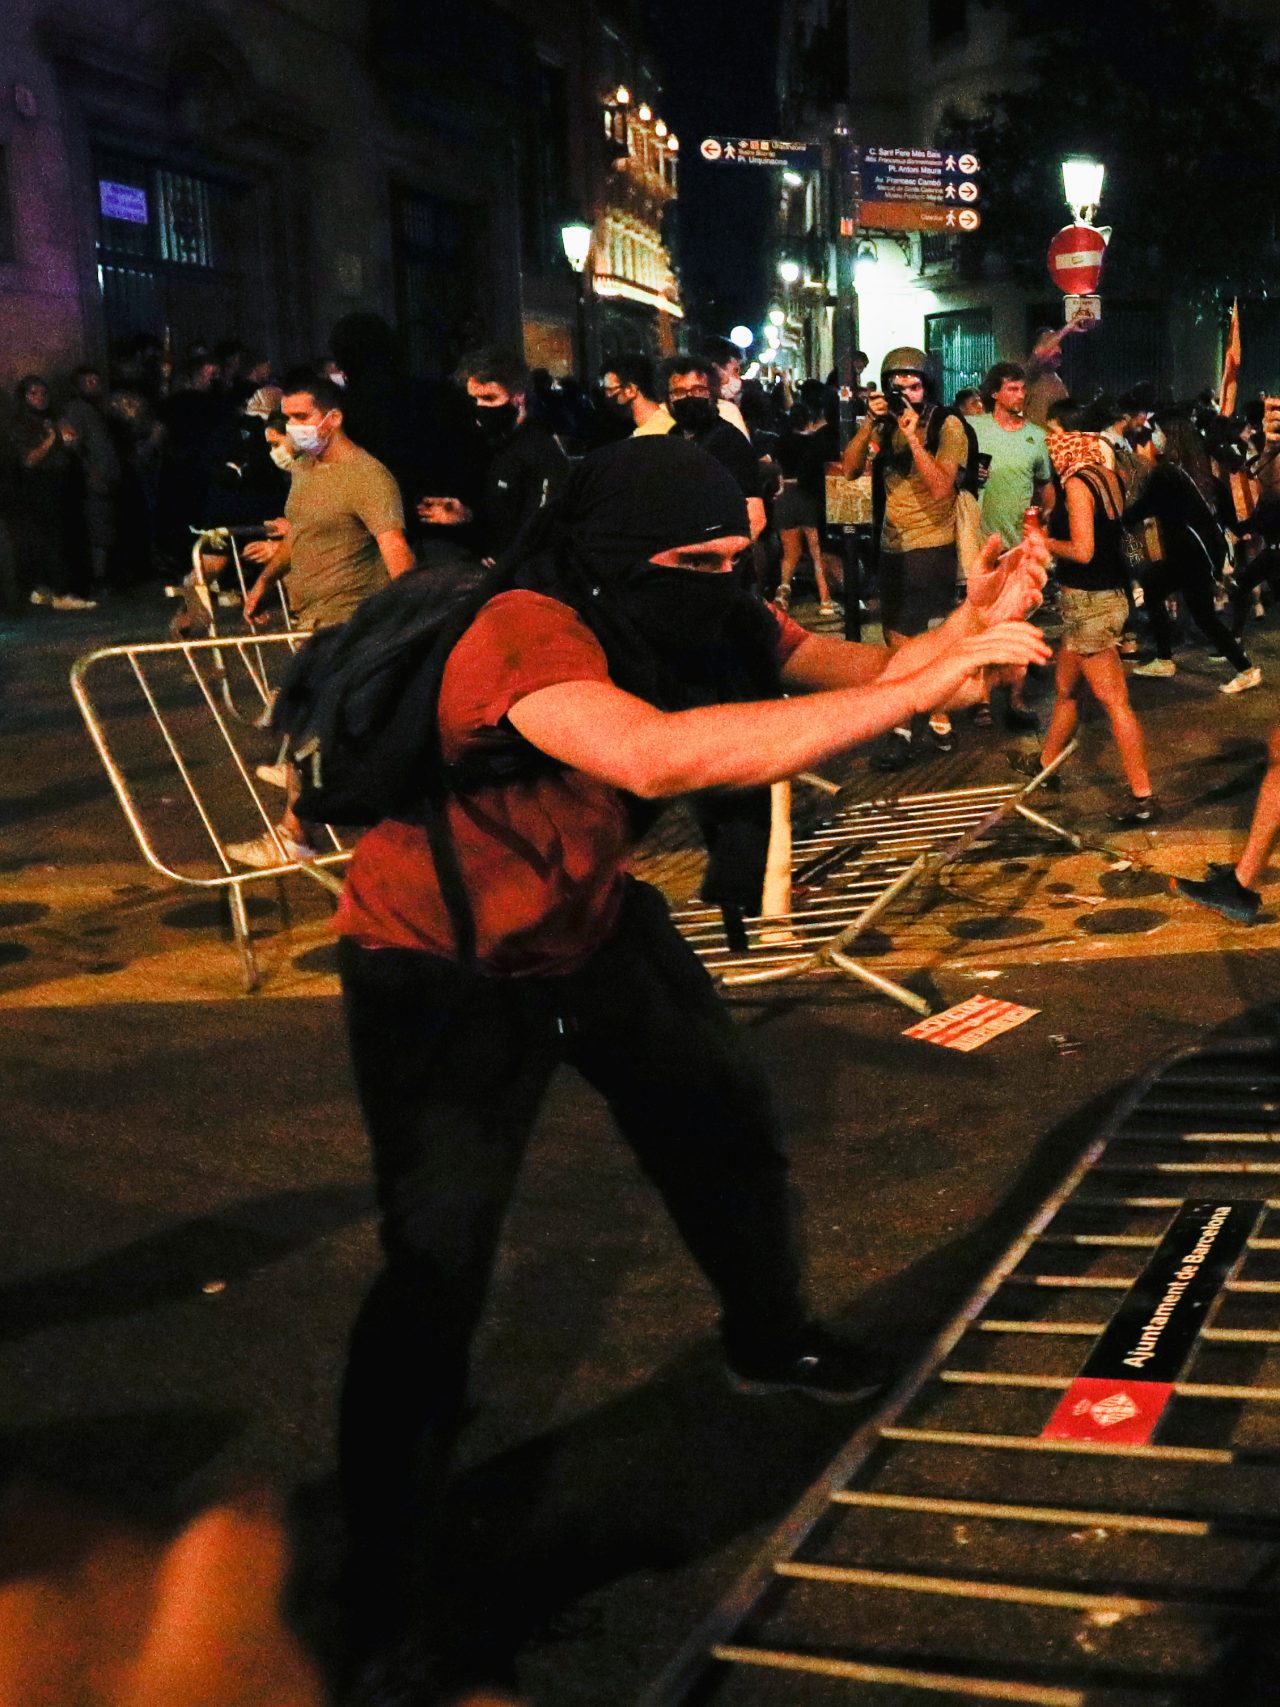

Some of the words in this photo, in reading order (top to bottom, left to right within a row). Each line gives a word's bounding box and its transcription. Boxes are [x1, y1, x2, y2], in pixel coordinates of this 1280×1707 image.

[895, 149, 910, 157] Pere
[749, 156, 788, 165] Urquinaona
[886, 177, 916, 185] Francesc
[1182, 1206, 1232, 1264] Barcelona
[1174, 1264, 1199, 1279] de
[1122, 1280, 1189, 1368] Ajuntament
